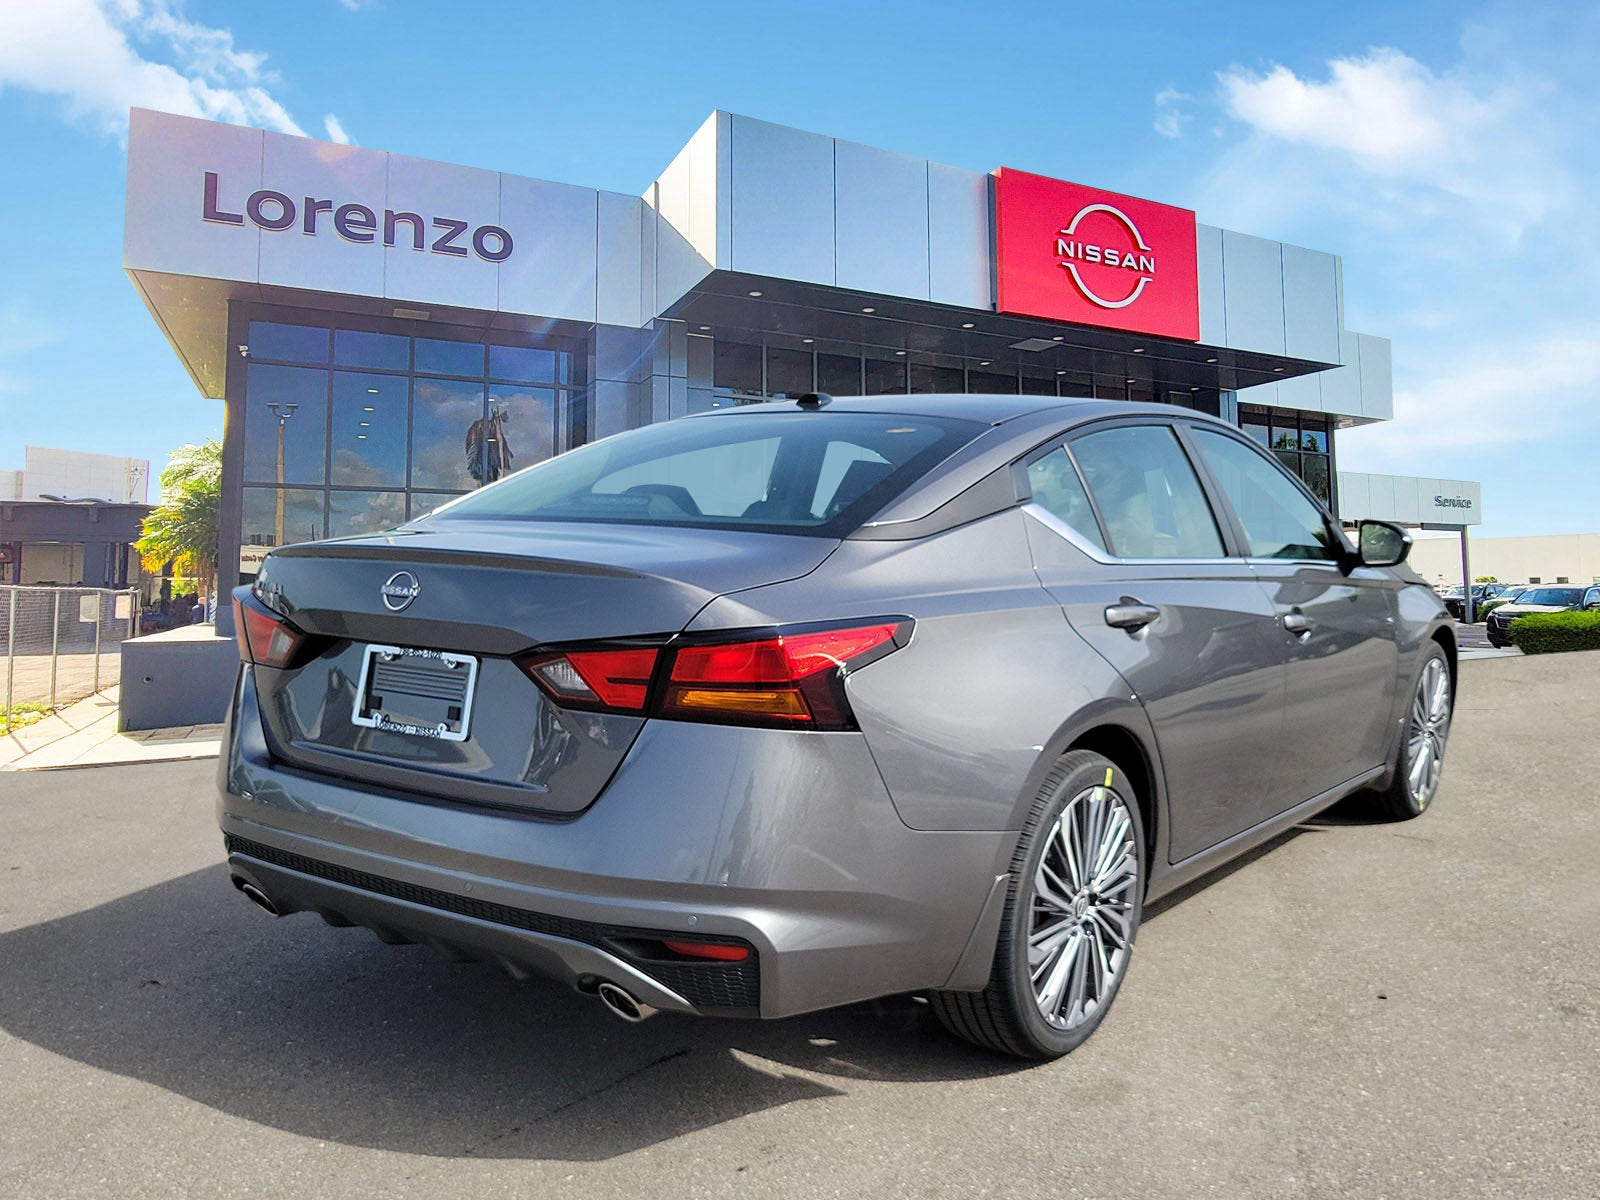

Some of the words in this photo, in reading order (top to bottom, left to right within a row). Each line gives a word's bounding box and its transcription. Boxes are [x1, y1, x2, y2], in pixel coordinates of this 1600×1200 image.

[202, 171, 514, 262] Lorenzo
[1056, 238, 1155, 273] NISSAN
[1434, 495, 1472, 509] Service
